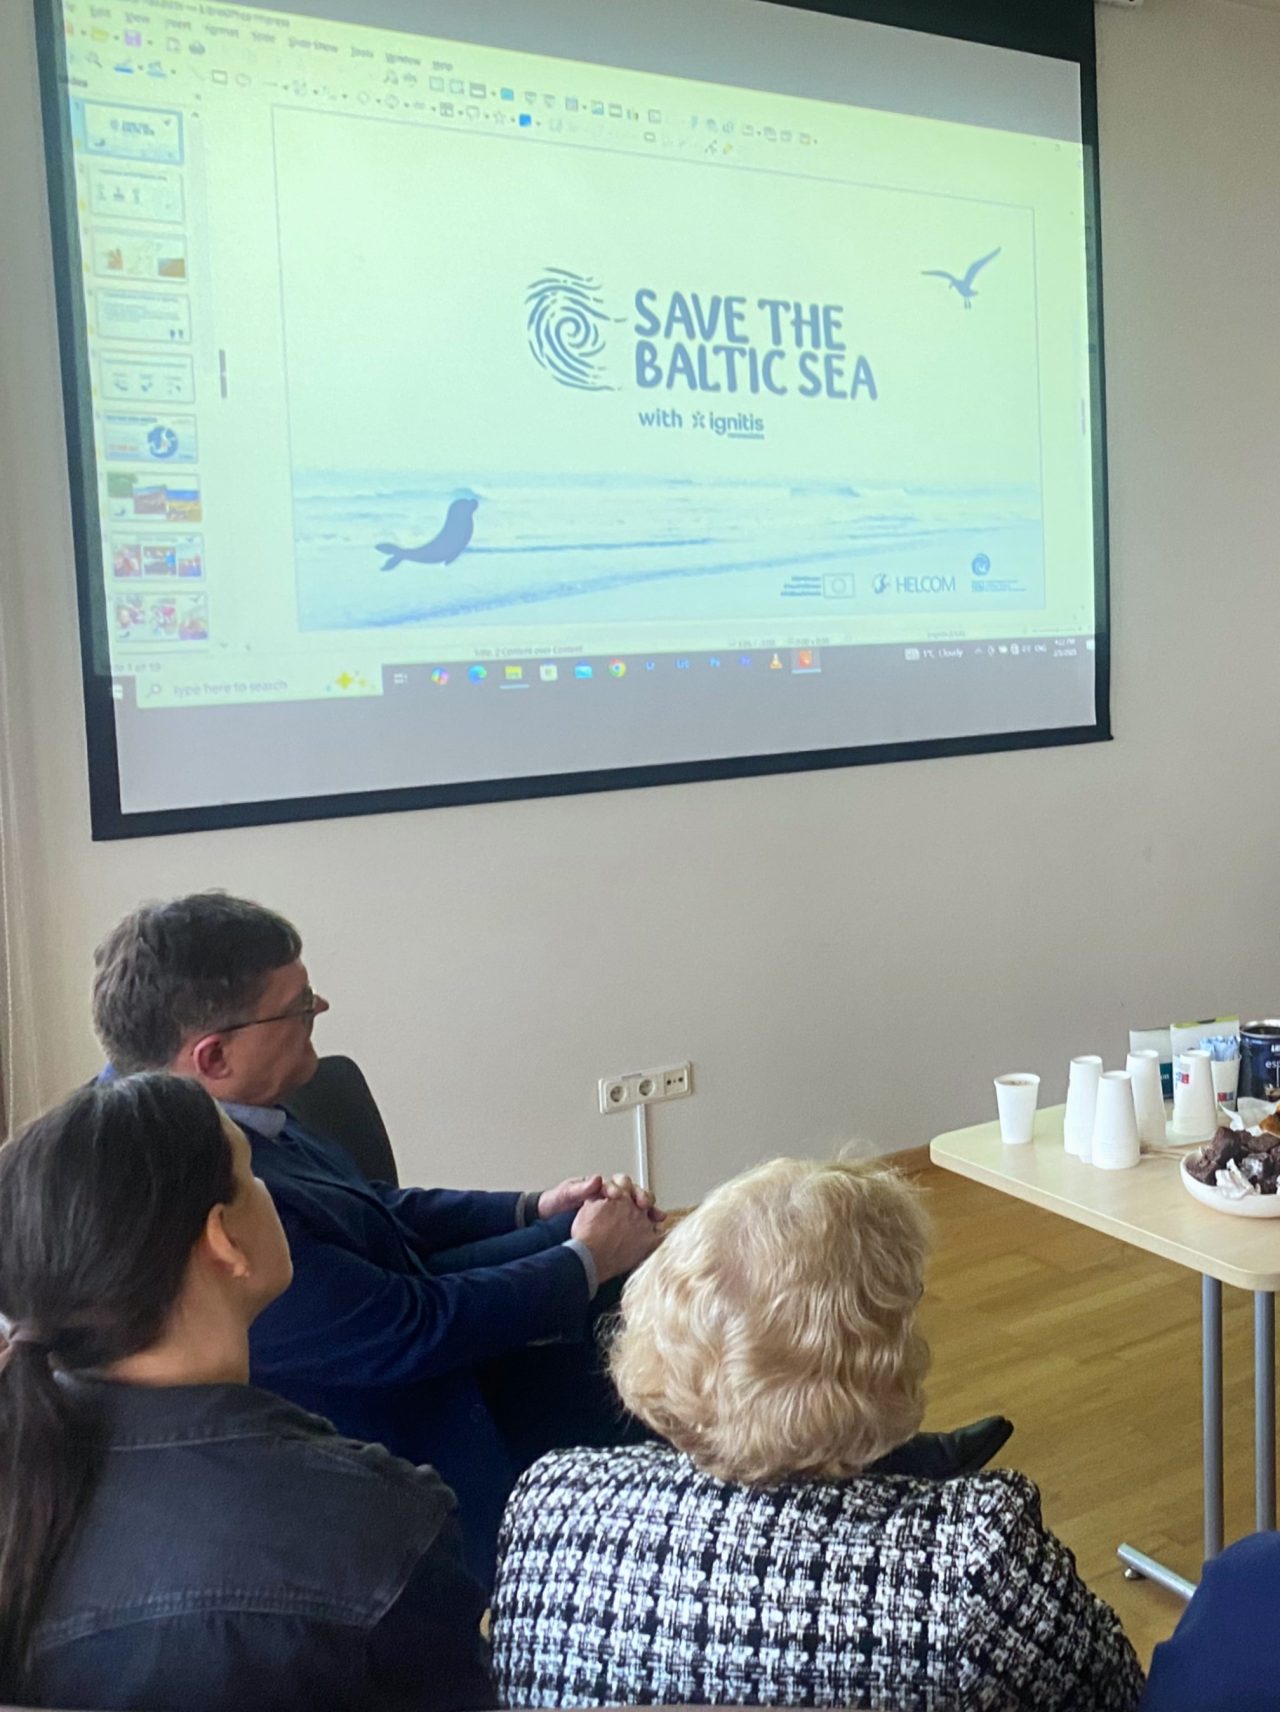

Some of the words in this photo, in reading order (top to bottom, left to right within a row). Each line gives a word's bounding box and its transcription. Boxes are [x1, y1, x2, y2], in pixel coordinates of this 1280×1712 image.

[634, 288, 750, 344] SAVE
[757, 299, 846, 351] THE
[635, 340, 788, 395] BALTIC
[798, 351, 878, 401] SEA
[638, 408, 683, 429] with
[709, 411, 765, 435] ignitis
[896, 575, 956, 593] HELCOM
[249, 680, 288, 693] search
